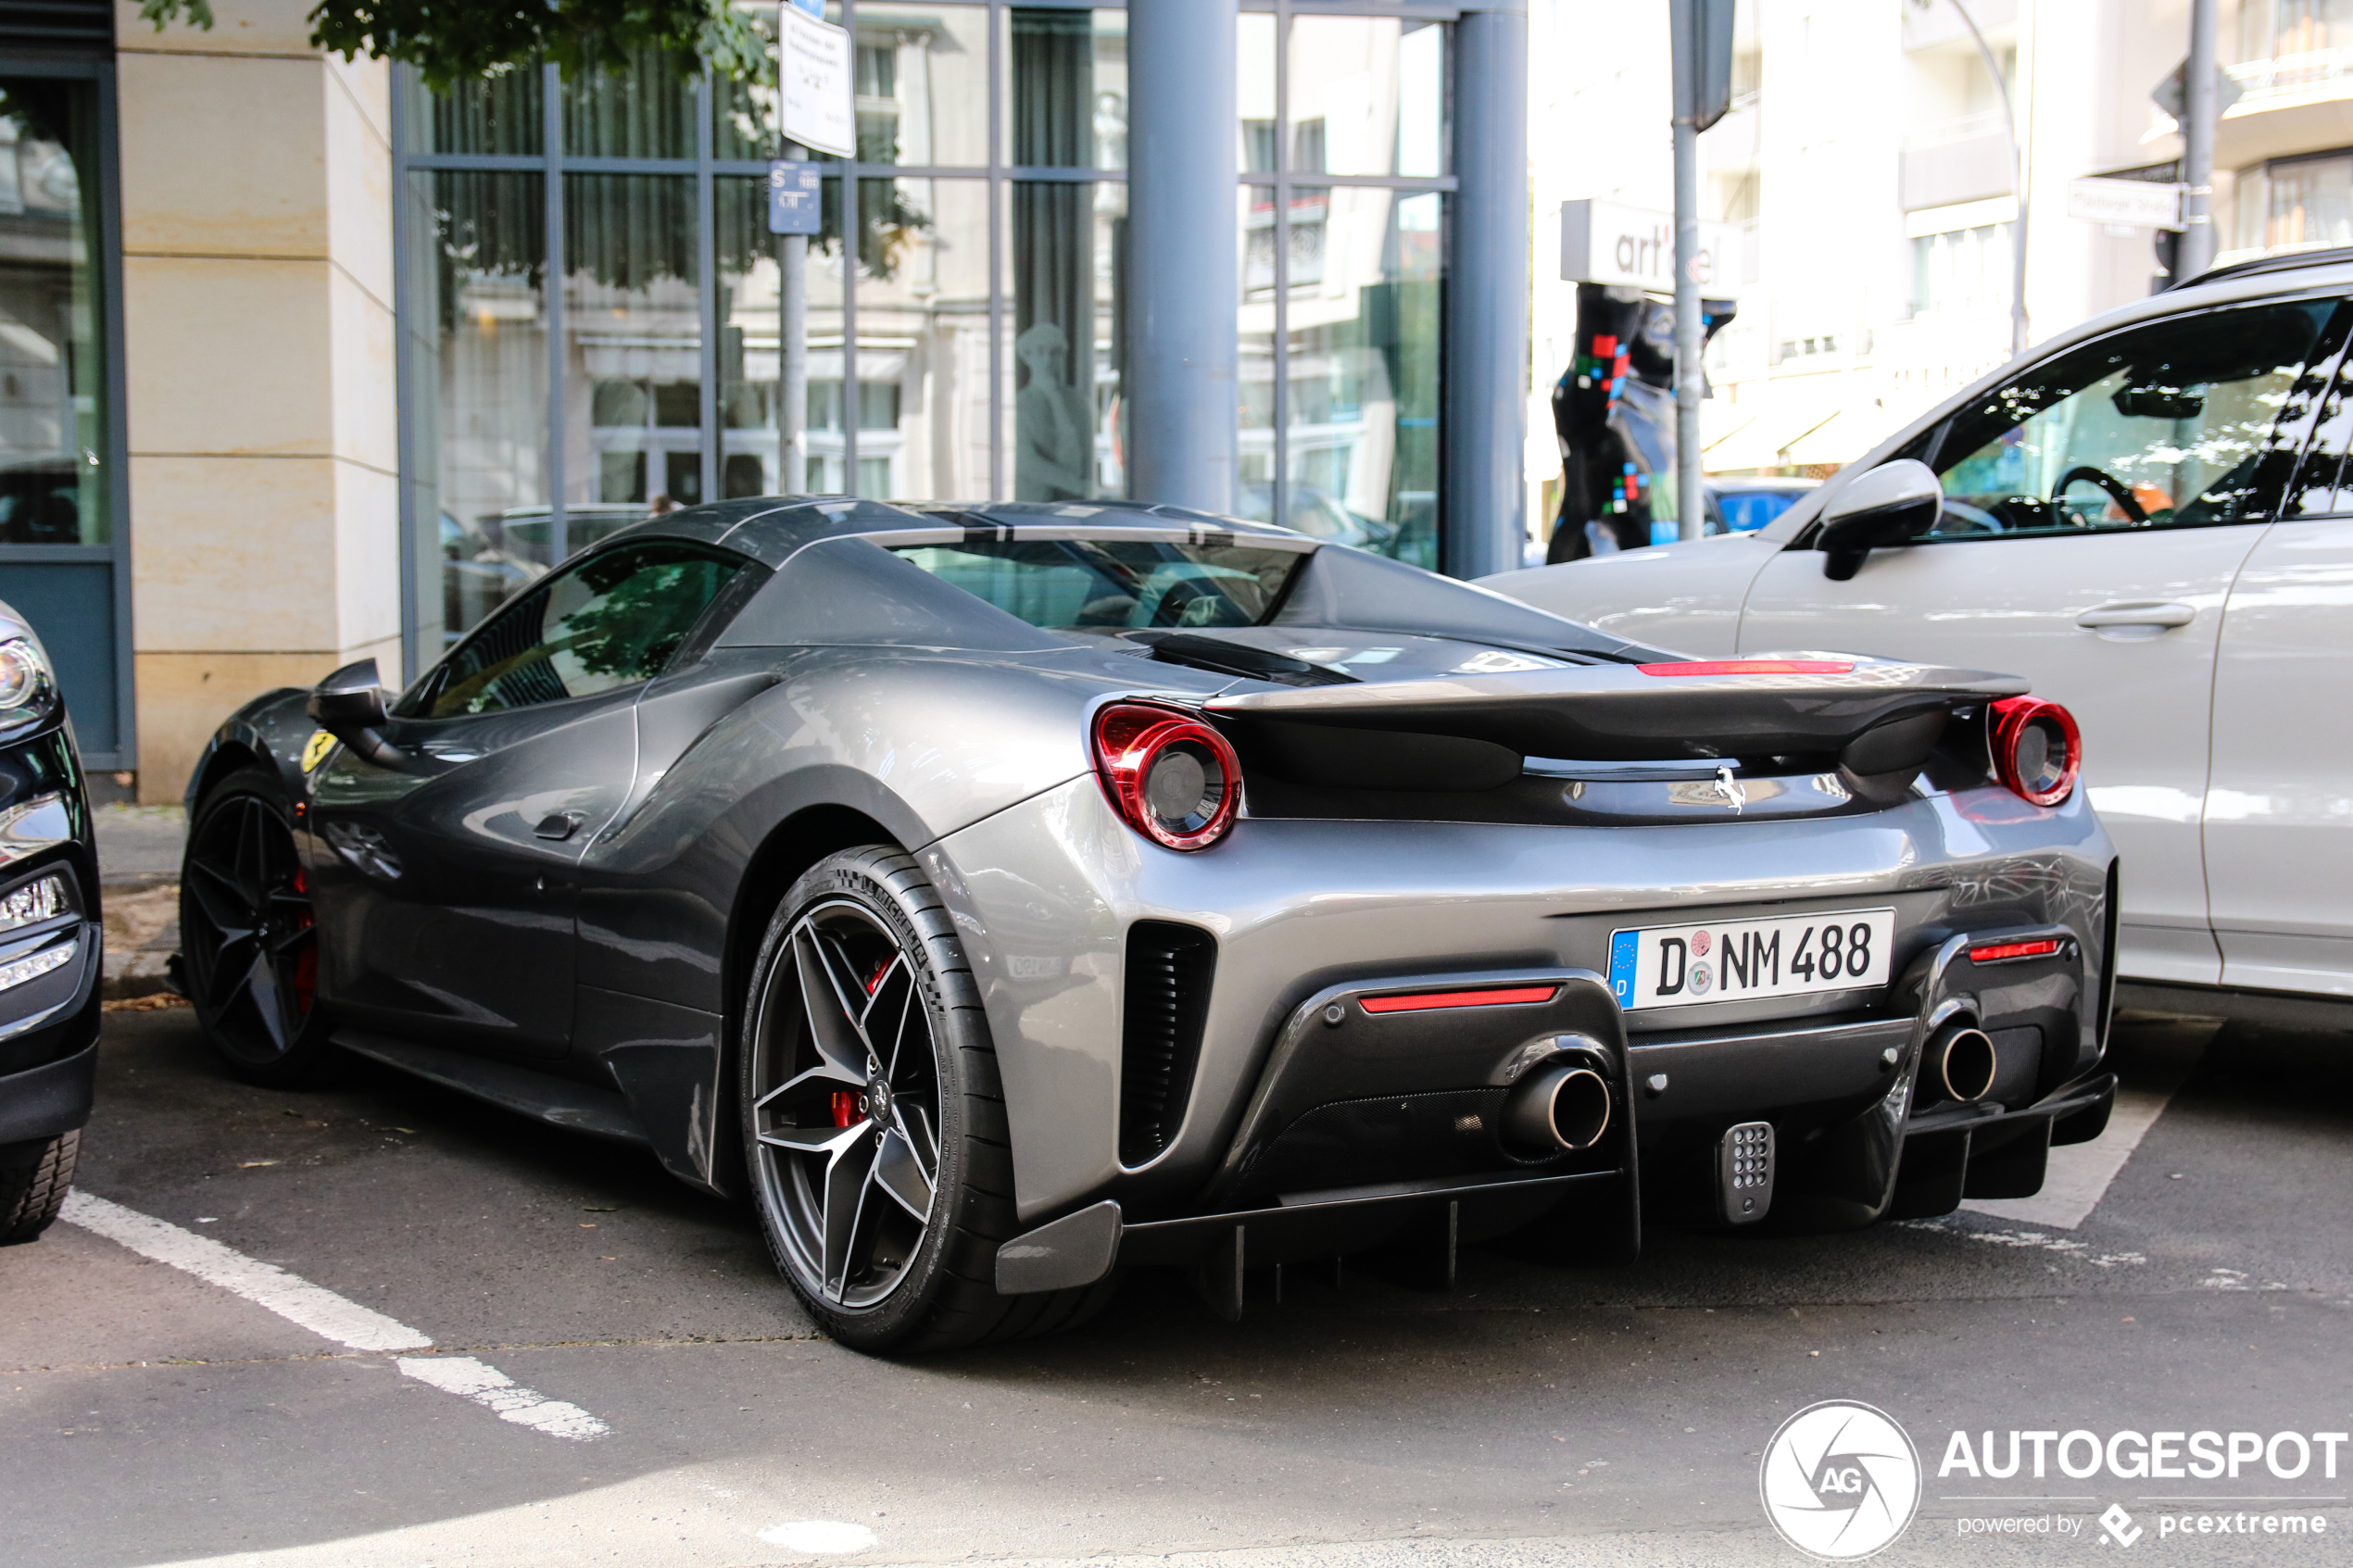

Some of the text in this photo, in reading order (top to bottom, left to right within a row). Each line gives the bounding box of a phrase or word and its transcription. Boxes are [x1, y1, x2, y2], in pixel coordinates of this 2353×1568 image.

[771, 169, 786, 188] S
[1617, 224, 1720, 286] art'el
[875, 887, 928, 965] MICHELIN
[1616, 980, 1627, 997] D
[1656, 922, 1872, 996] D NM 488
